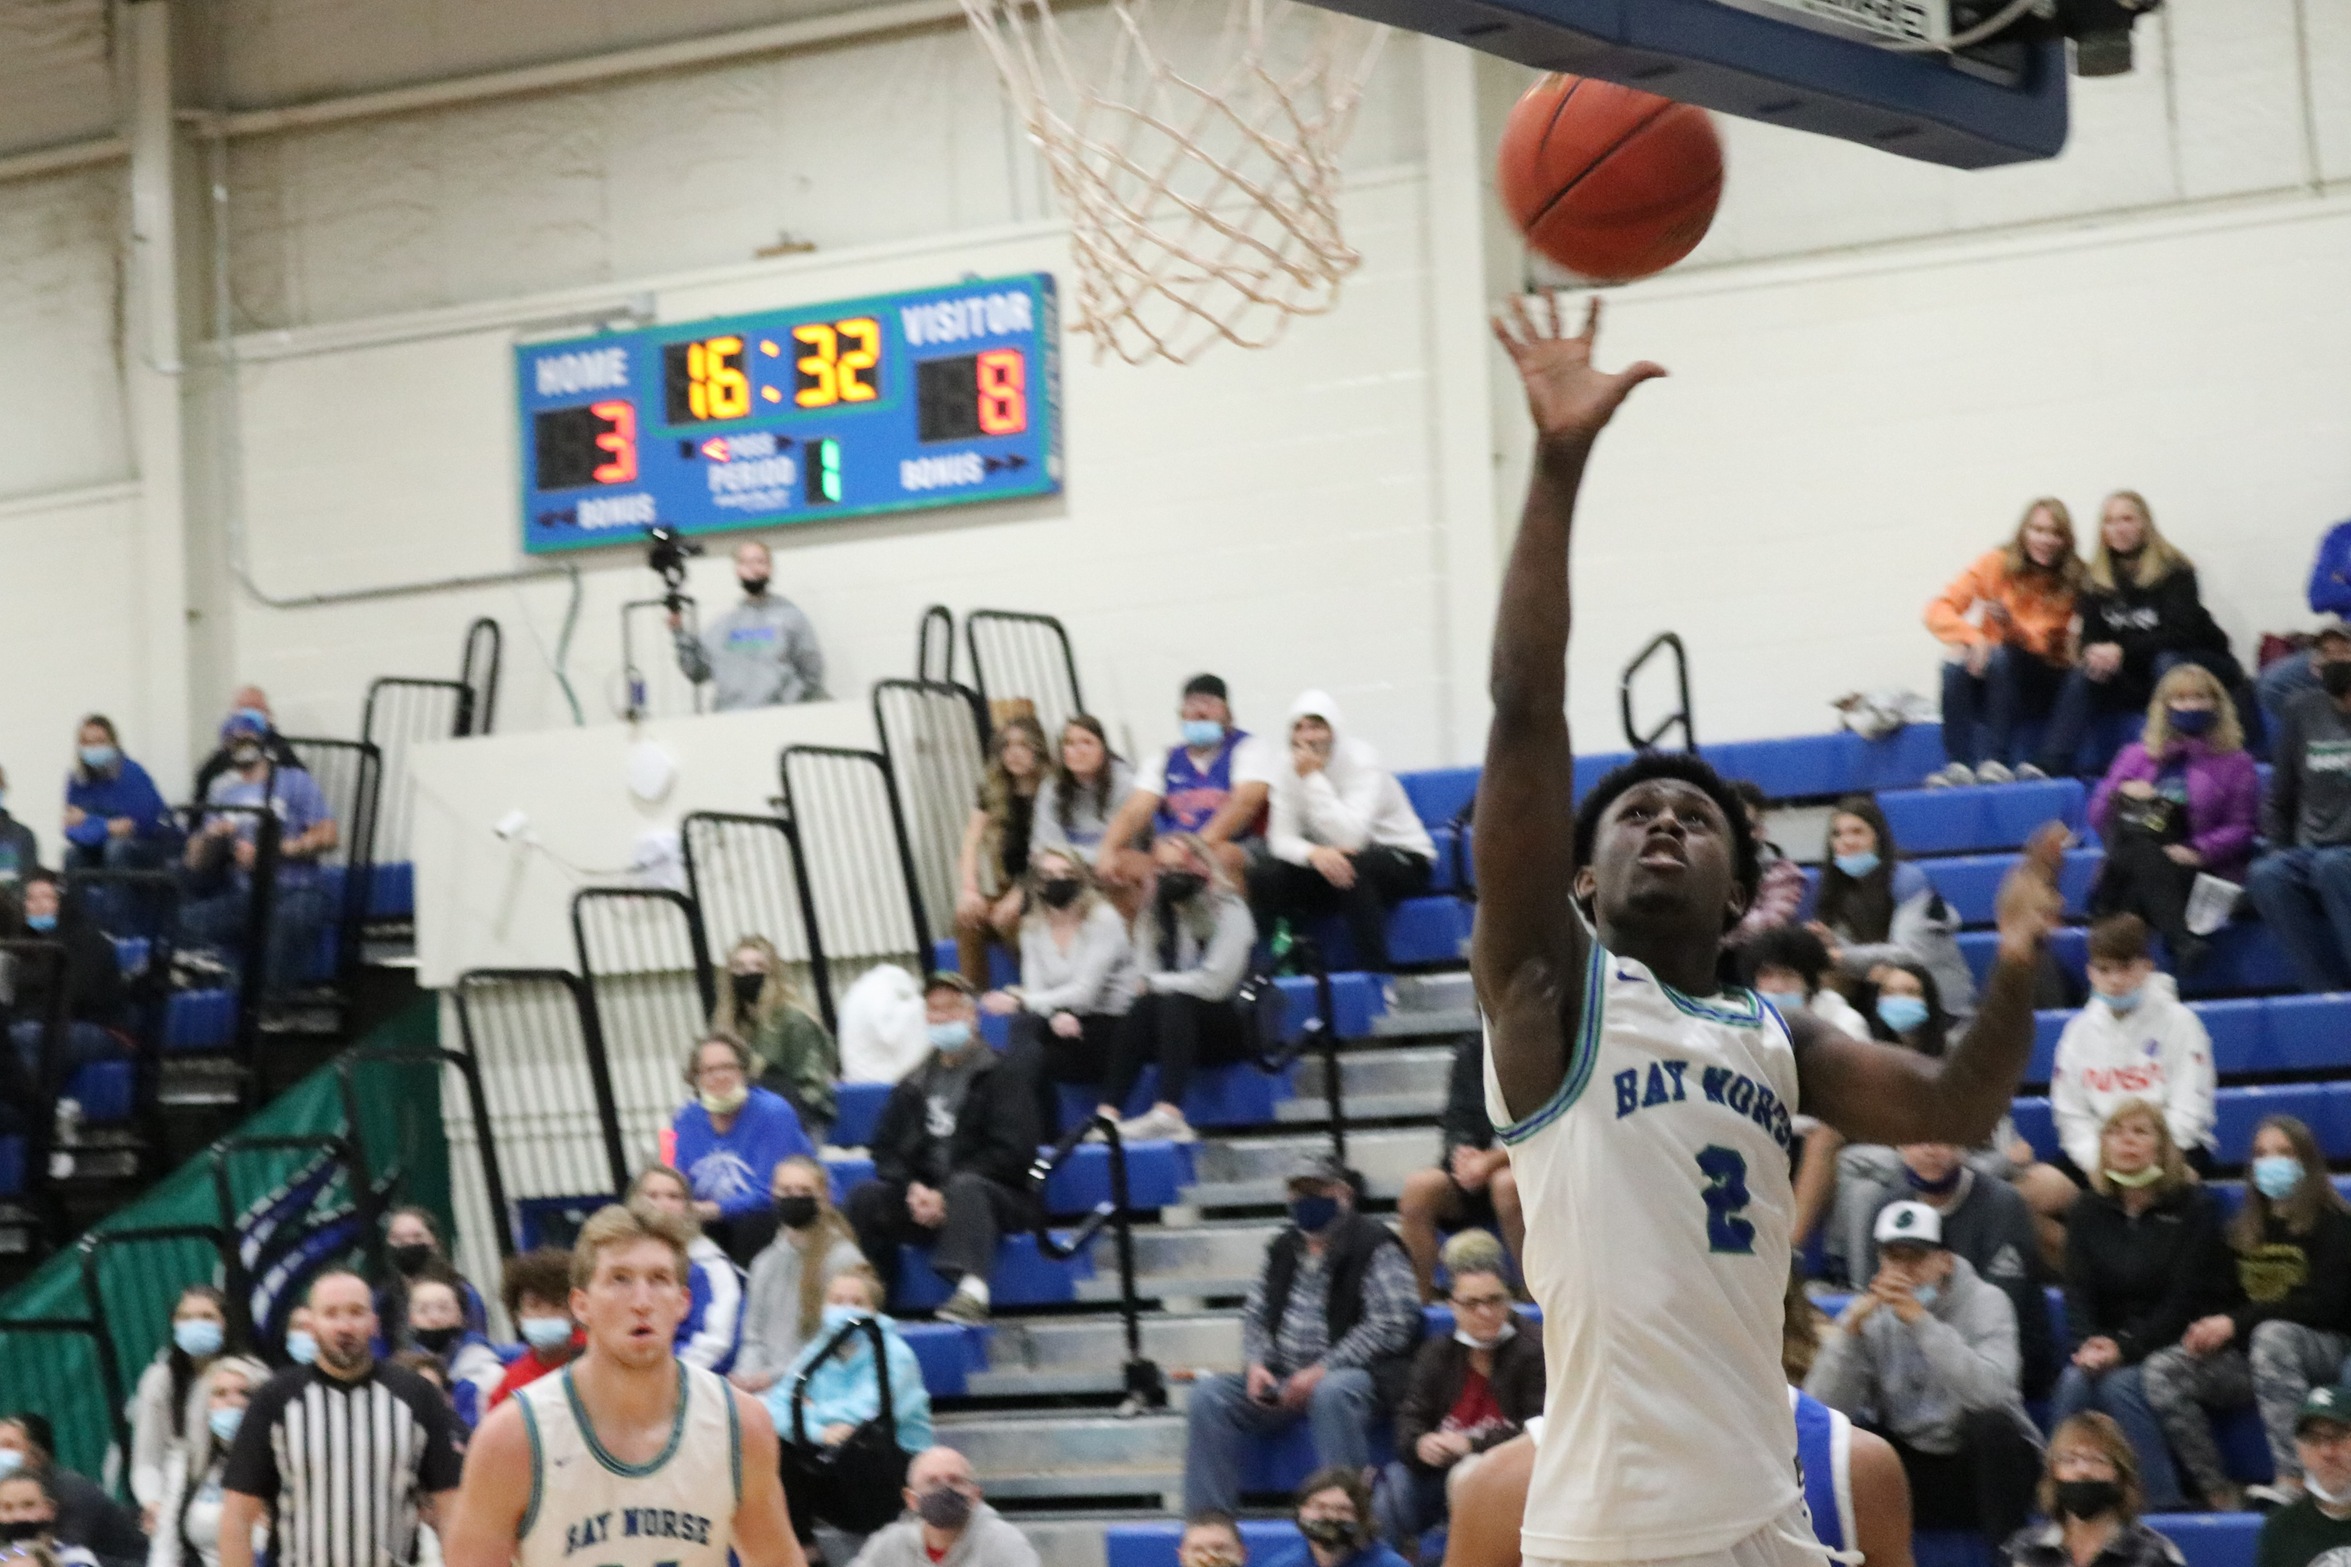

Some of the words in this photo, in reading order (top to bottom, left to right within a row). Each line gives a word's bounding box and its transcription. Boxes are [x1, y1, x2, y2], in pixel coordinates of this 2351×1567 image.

[902, 291, 1032, 345] VISITOR
[536, 348, 627, 396] HOME
[687, 317, 881, 420] 16:32
[976, 348, 1027, 435] 8
[589, 399, 637, 484] 3
[821, 438, 841, 502] 1
[901, 451, 985, 490] BONUS
[708, 456, 796, 494] PERIOD
[577, 493, 655, 529] BONUS
[1614, 1060, 1688, 1119] BAY
[1702, 1064, 1792, 1150] NORS
[1696, 1143, 1756, 1254] 2
[622, 1507, 711, 1547] NORSE
